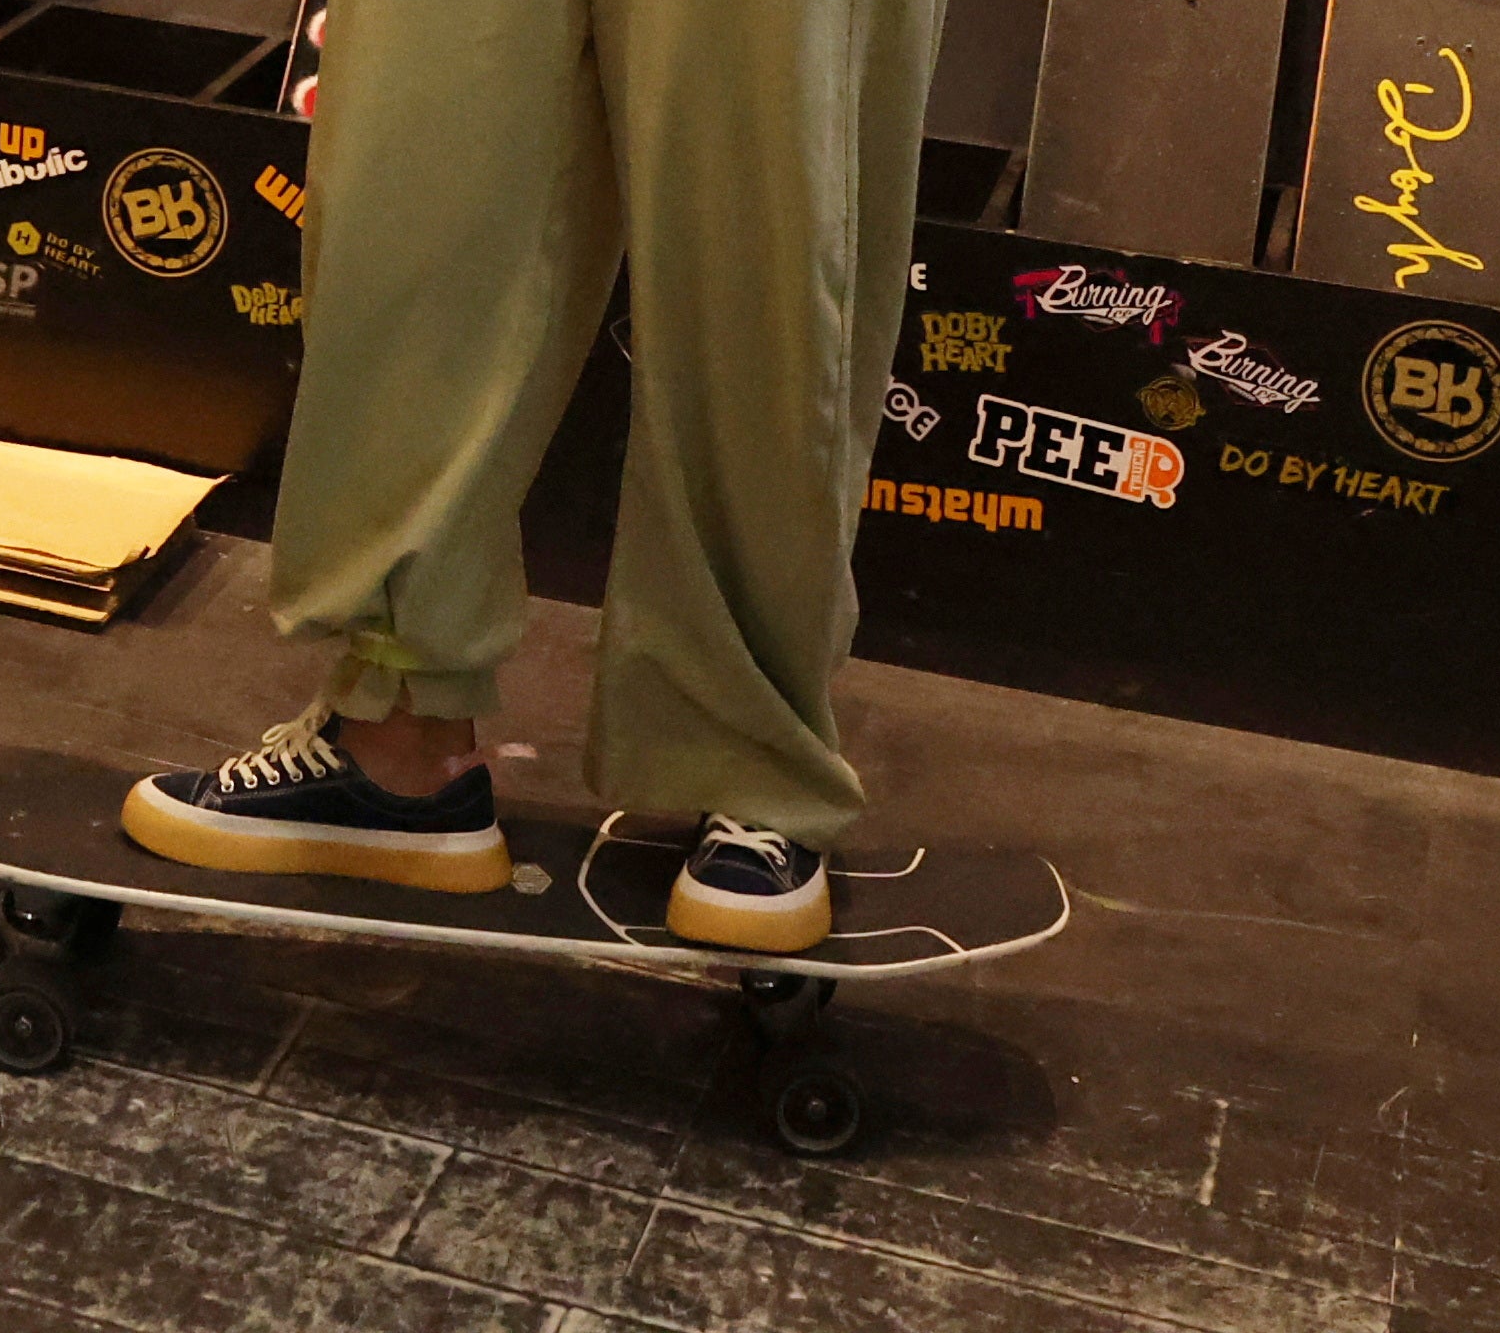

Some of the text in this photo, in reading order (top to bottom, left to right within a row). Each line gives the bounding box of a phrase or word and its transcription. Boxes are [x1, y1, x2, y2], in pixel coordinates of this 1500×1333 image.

[1034, 263, 1174, 325] Burning
[920, 312, 1009, 343] DOBY
[920, 340, 1014, 374] HEART
[1188, 328, 1322, 415] Burning
[860, 479, 1043, 533] whatsu
[1219, 445, 1450, 517] DO BY HEART
